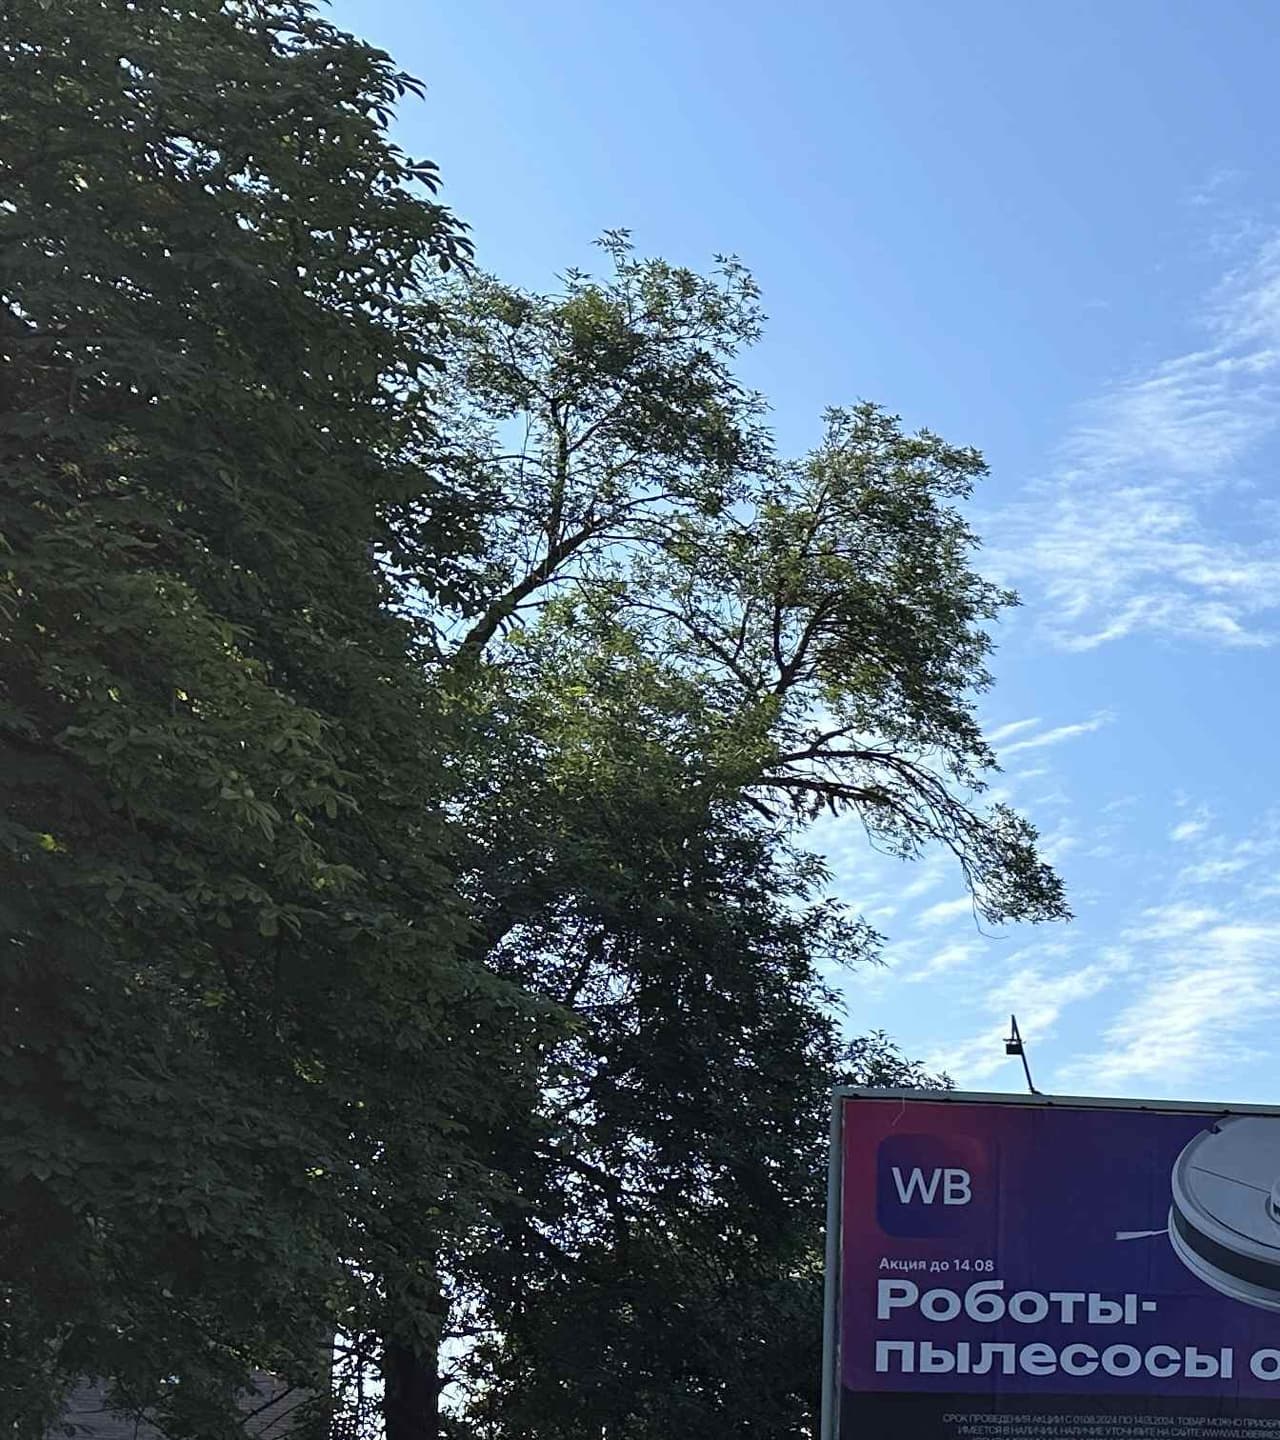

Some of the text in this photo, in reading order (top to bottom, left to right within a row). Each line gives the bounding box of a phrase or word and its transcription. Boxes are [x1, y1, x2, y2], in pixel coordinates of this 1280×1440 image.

[892, 1166, 972, 1206] WB
[879, 1257, 995, 1272] Акция до 14.08
[876, 1278, 1158, 1326] Роботы-
[874, 1339, 1234, 1379] пылесосы
